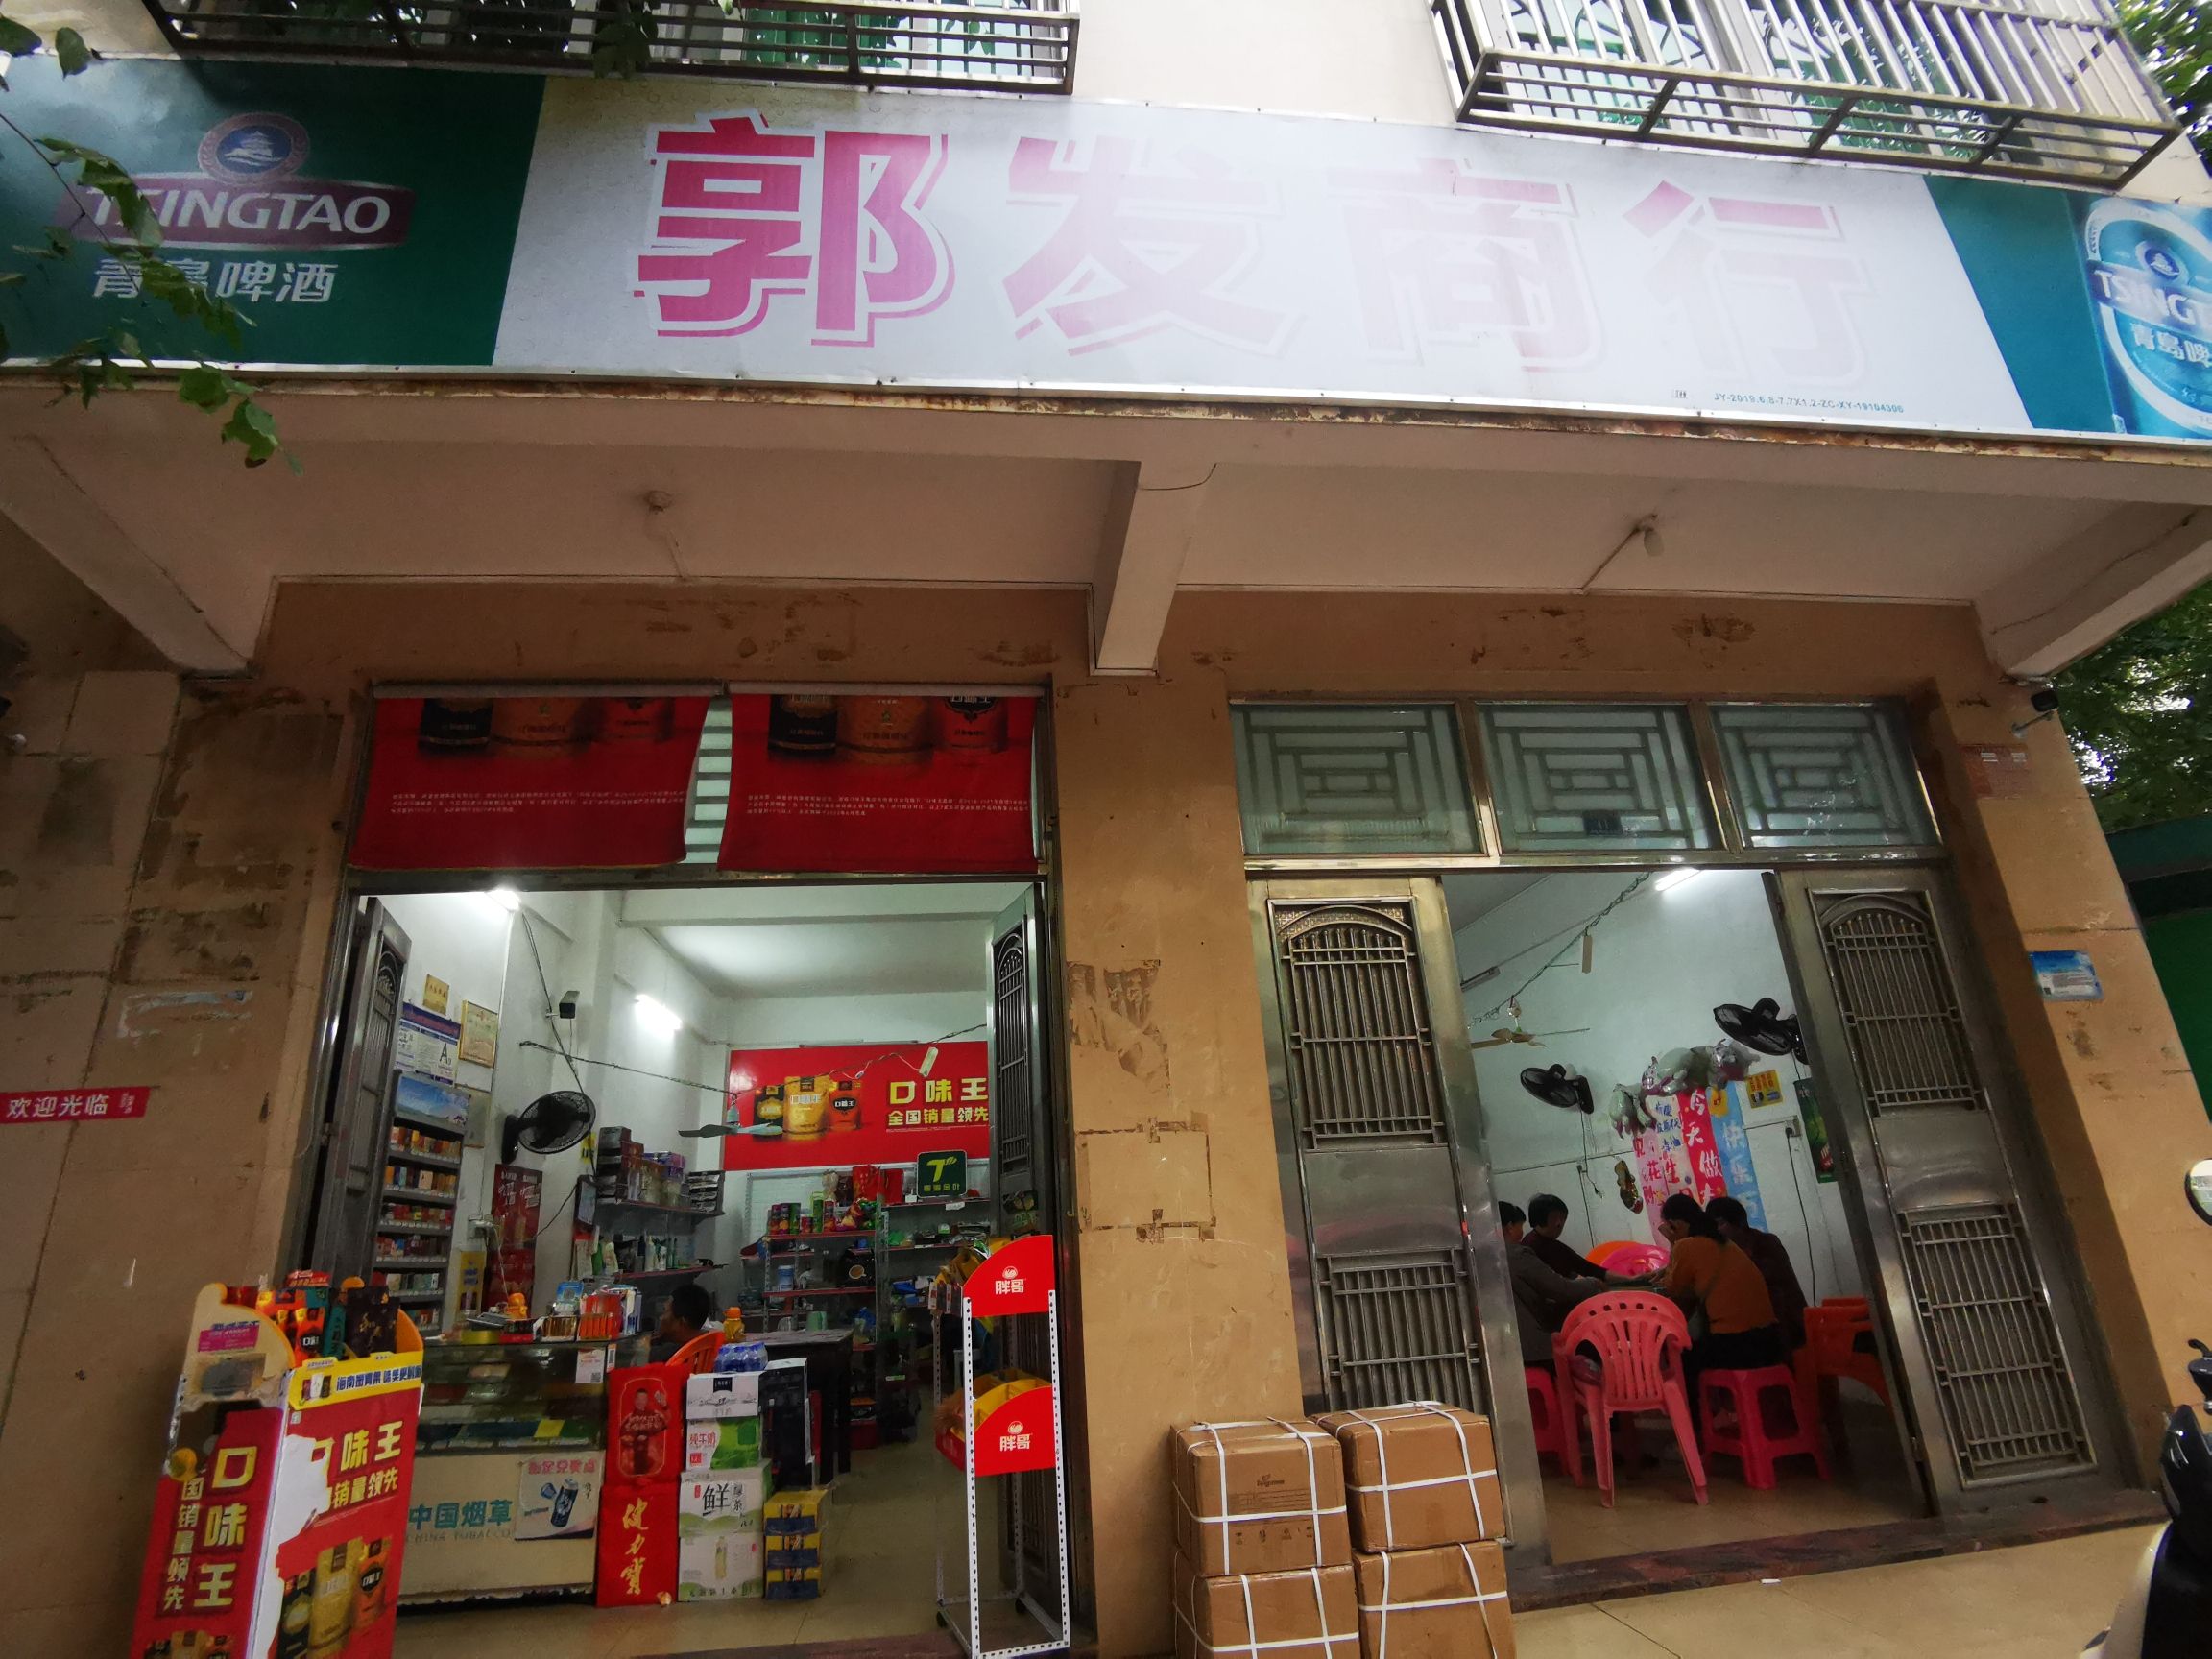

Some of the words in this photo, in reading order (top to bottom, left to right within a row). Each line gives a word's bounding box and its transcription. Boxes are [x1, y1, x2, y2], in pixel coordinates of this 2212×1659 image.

[87, 189, 391, 234] TINGTAO
[635, 113, 1871, 385] 郭发商行
[889, 1077, 989, 1104] 口味王
[6, 1094, 109, 1119] 欢迎光临
[888, 1106, 989, 1126] 全国销量领先
[995, 1279, 1024, 1294] 胖哥
[999, 1434, 1031, 1451] 胖哥
[327, 1466, 398, 1509] 销量领先
[193, 1446, 257, 1607] 口味王
[408, 1499, 513, 1530] 中国烟草
[163, 1476, 204, 1612] 国销量领先
